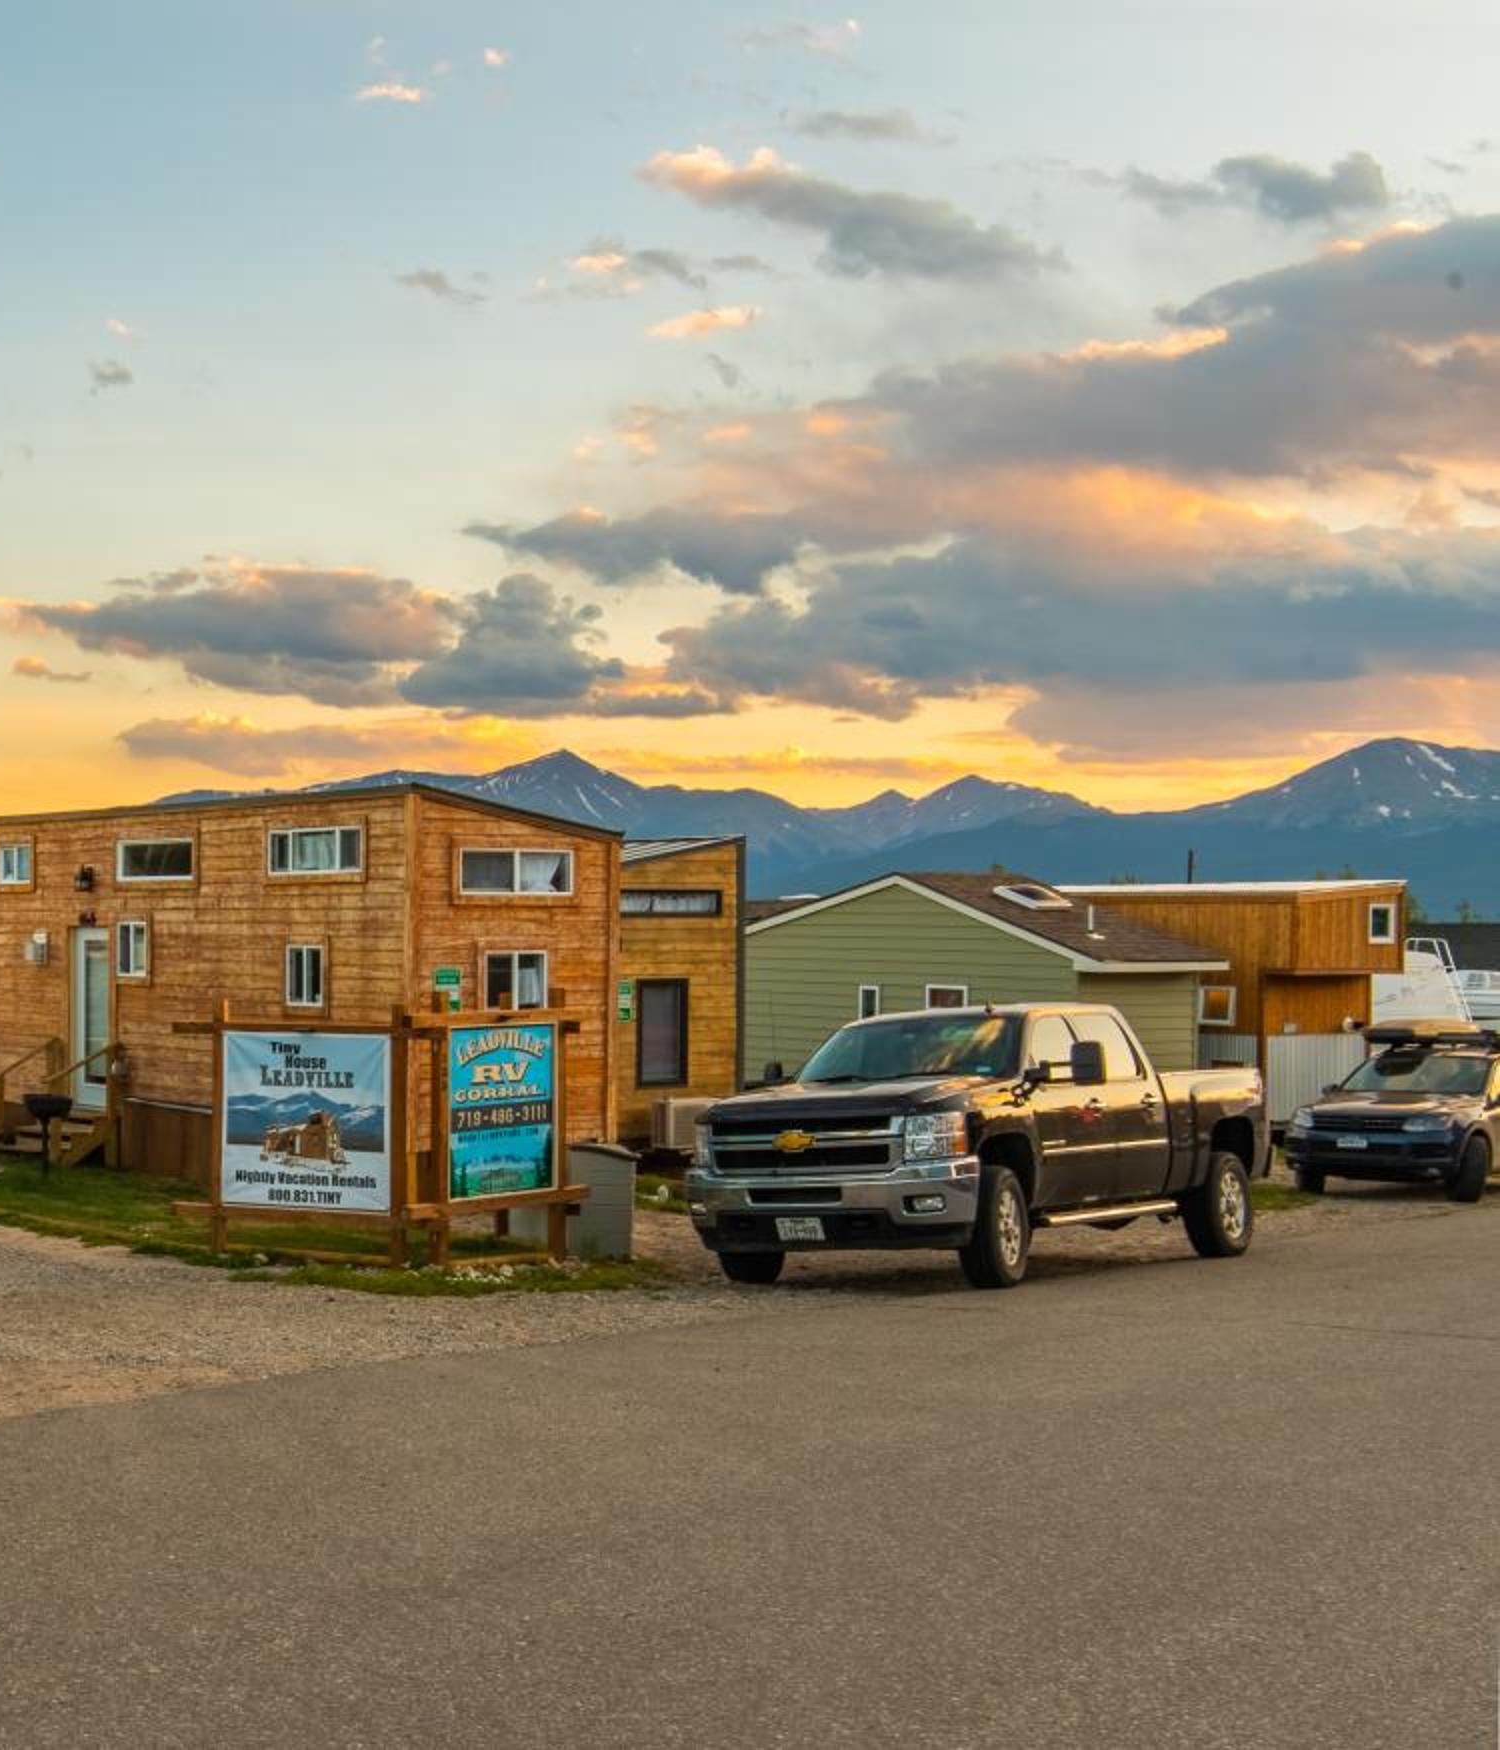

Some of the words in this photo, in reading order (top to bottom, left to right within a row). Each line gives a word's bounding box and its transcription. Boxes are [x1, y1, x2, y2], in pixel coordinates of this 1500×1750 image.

[269, 1042, 300, 1054] Tiny
[457, 1029, 545, 1066] LEADVILLE
[285, 1056, 327, 1069] House
[260, 1065, 354, 1088] LEADVILLE
[472, 1061, 529, 1084] RV
[455, 1085, 542, 1102] CORRAL
[235, 1170, 276, 1184] Nightly
[278, 1171, 329, 1186] Vacation
[331, 1174, 377, 1188] Rentals
